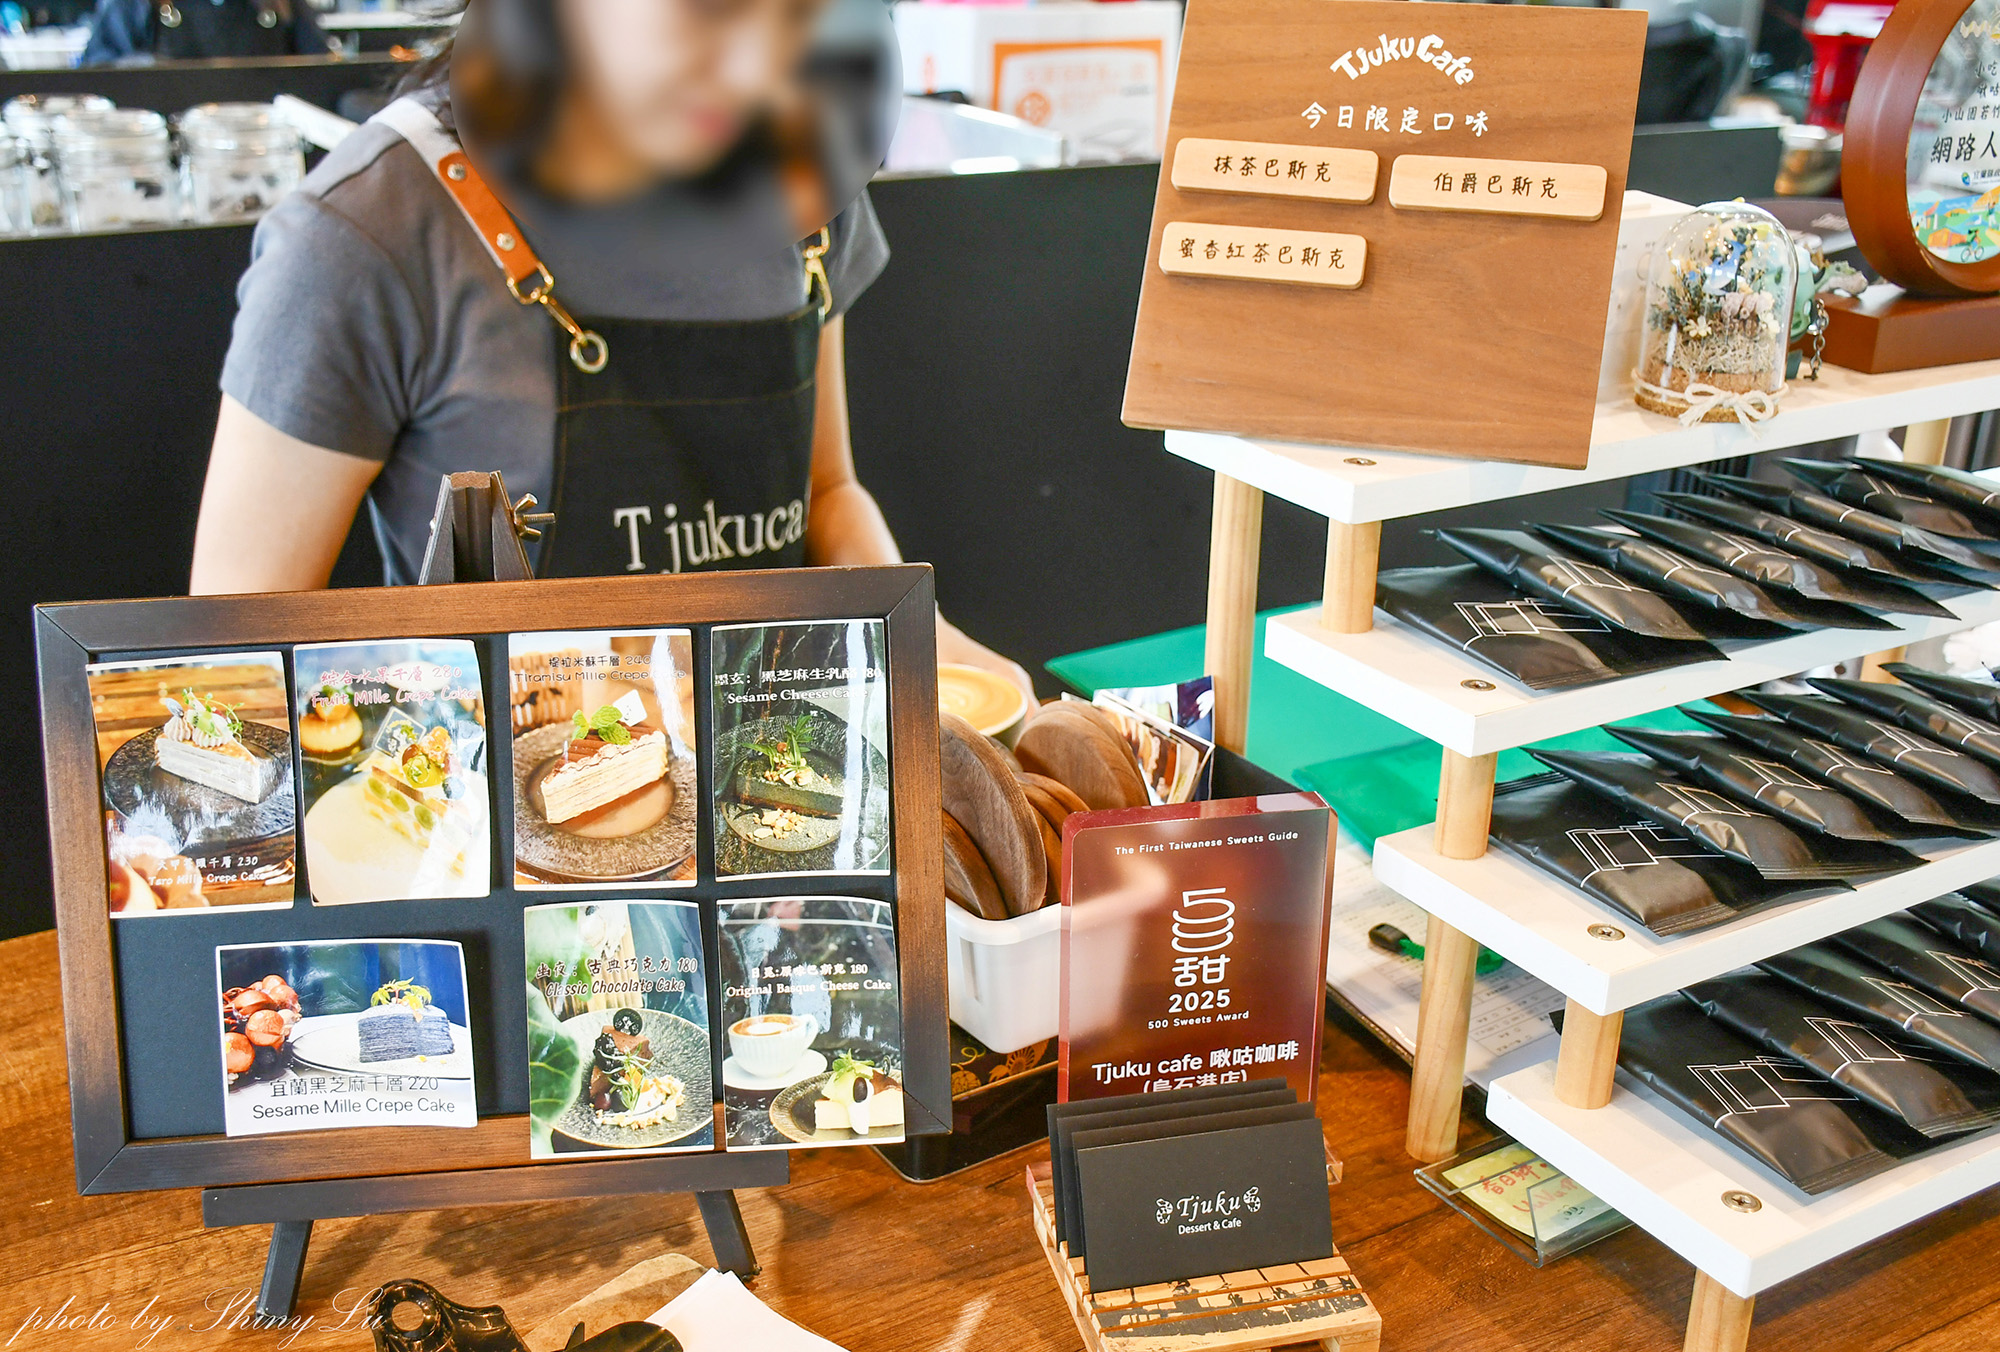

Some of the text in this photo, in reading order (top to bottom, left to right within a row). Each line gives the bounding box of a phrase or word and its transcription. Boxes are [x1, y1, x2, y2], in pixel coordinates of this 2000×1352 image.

[1330, 33, 1475, 86] Tjuku Cafe
[1300, 101, 1489, 138] 今日限定口味
[1930, 130, 1998, 164] 網路人
[1213, 155, 1332, 183] 抹茶巴斯克
[1433, 172, 1559, 199] 伯爵巴斯克
[1178, 237, 1346, 270] 蜜香紅茶巴斯克
[548, 654, 652, 668] 提拉米蘇千層 240
[320, 664, 463, 687] 綜合水果千層 280
[514, 673, 572, 683] Tiramisu
[575, 671, 607, 681] Mille
[610, 670, 649, 681] Crepe
[311, 685, 477, 708] Fruit Mille Crepe Cake
[727, 690, 778, 704] Sesame
[780, 688, 829, 701] Cheese
[1115, 830, 1299, 856] The First Taiwanese Sweets Guide
[237, 855, 259, 867] 230
[149, 875, 173, 887] Taro
[206, 872, 238, 885] Crepe
[587, 956, 671, 977] 古典巧克力
[677, 956, 699, 973] 180
[850, 963, 869, 976] 180
[1171, 953, 1232, 988] 甜
[545, 976, 686, 998] Classic Chocolate Cake
[725, 978, 893, 999] Original Basque Cheese Cake
[1168, 988, 1232, 1014] 2025
[1148, 1010, 1250, 1030] 500 Sweets Award
[1091, 1040, 1300, 1085] Tjuku cafe 啾咕咖啡
[269, 1075, 440, 1098] 宜蘭黑芝麻千層 220
[252, 1096, 456, 1120] Sesame Mille Crepe Cake
[1176, 1190, 1241, 1222] Tjuku
[1178, 1217, 1242, 1235] Dessert & Cafe
